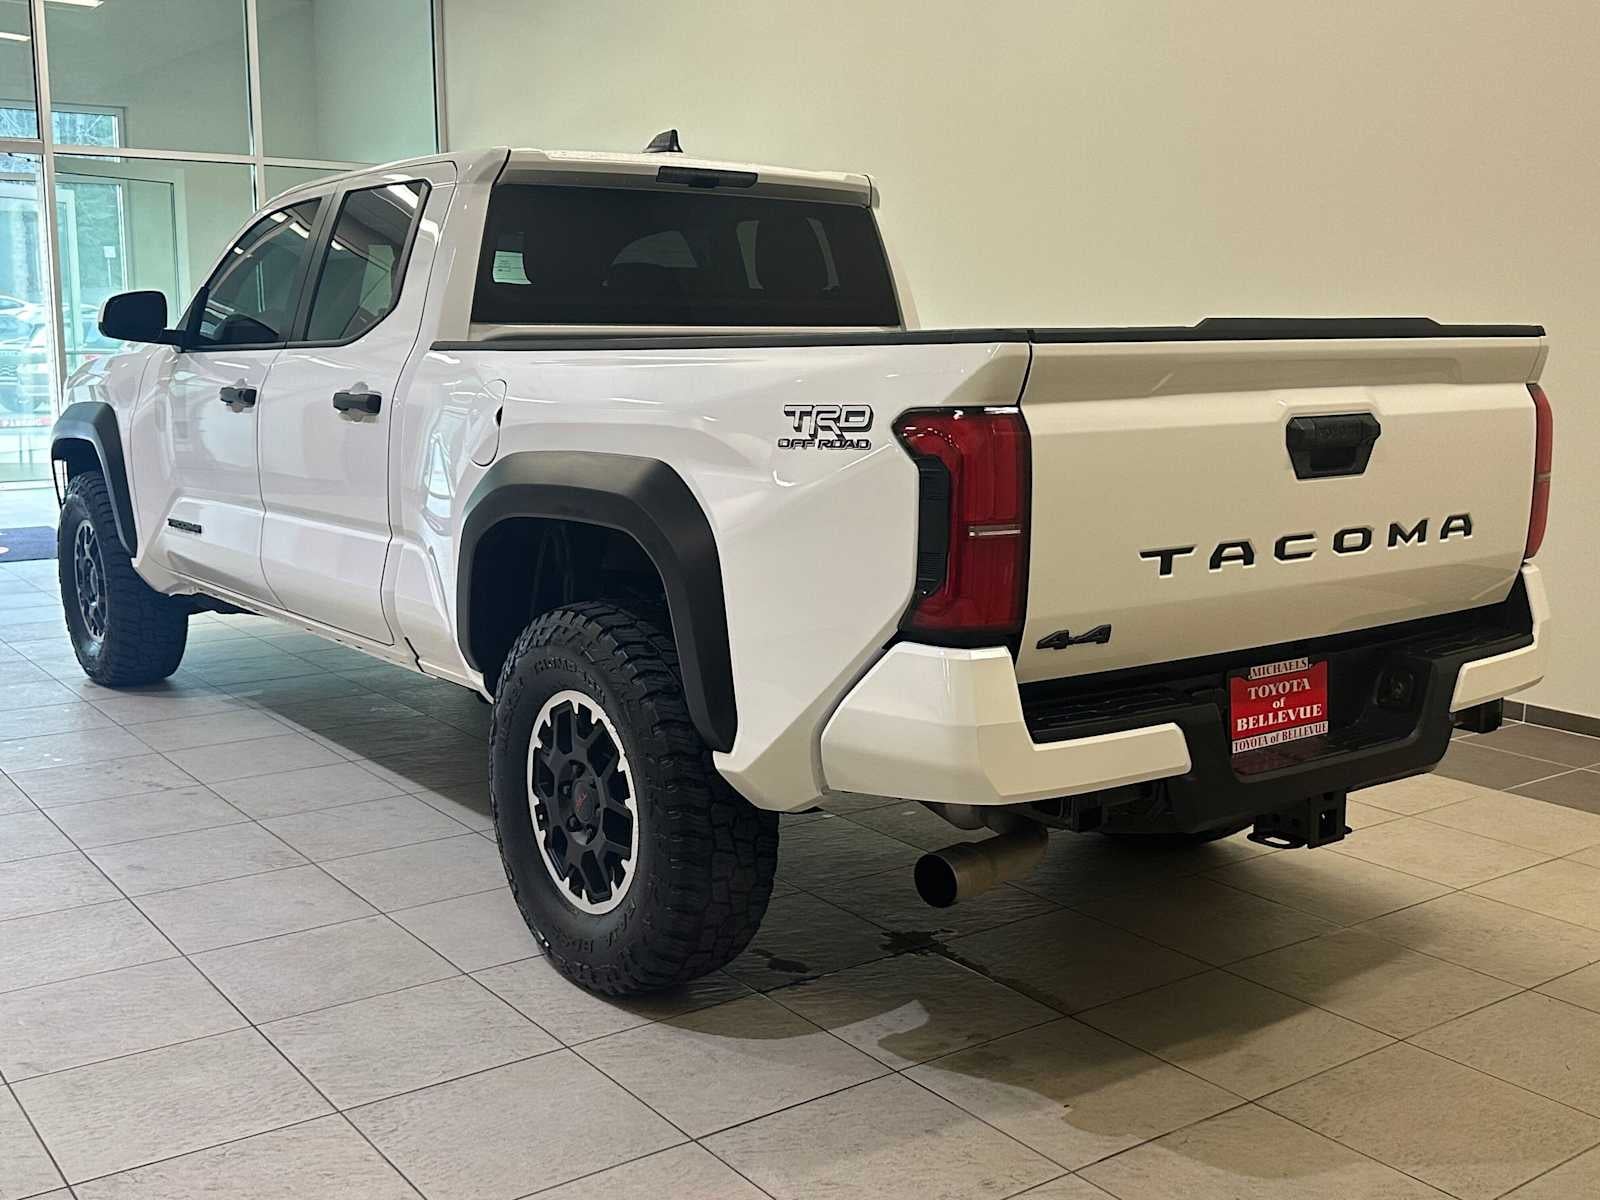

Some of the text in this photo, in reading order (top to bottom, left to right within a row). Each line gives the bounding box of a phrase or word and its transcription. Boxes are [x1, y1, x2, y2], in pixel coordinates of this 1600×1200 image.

[783, 404, 873, 439] TRD
[778, 438, 871, 450] OFF ROAD
[1139, 512, 1473, 577] TACOMA
[1252, 659, 1307, 677] MICHAELS
[1248, 678, 1311, 700] TOYOTA
[1272, 697, 1286, 709] of
[1237, 703, 1322, 732] BELLEVUE
[1234, 722, 1327, 752] TOYOTA of BELLEVUE
